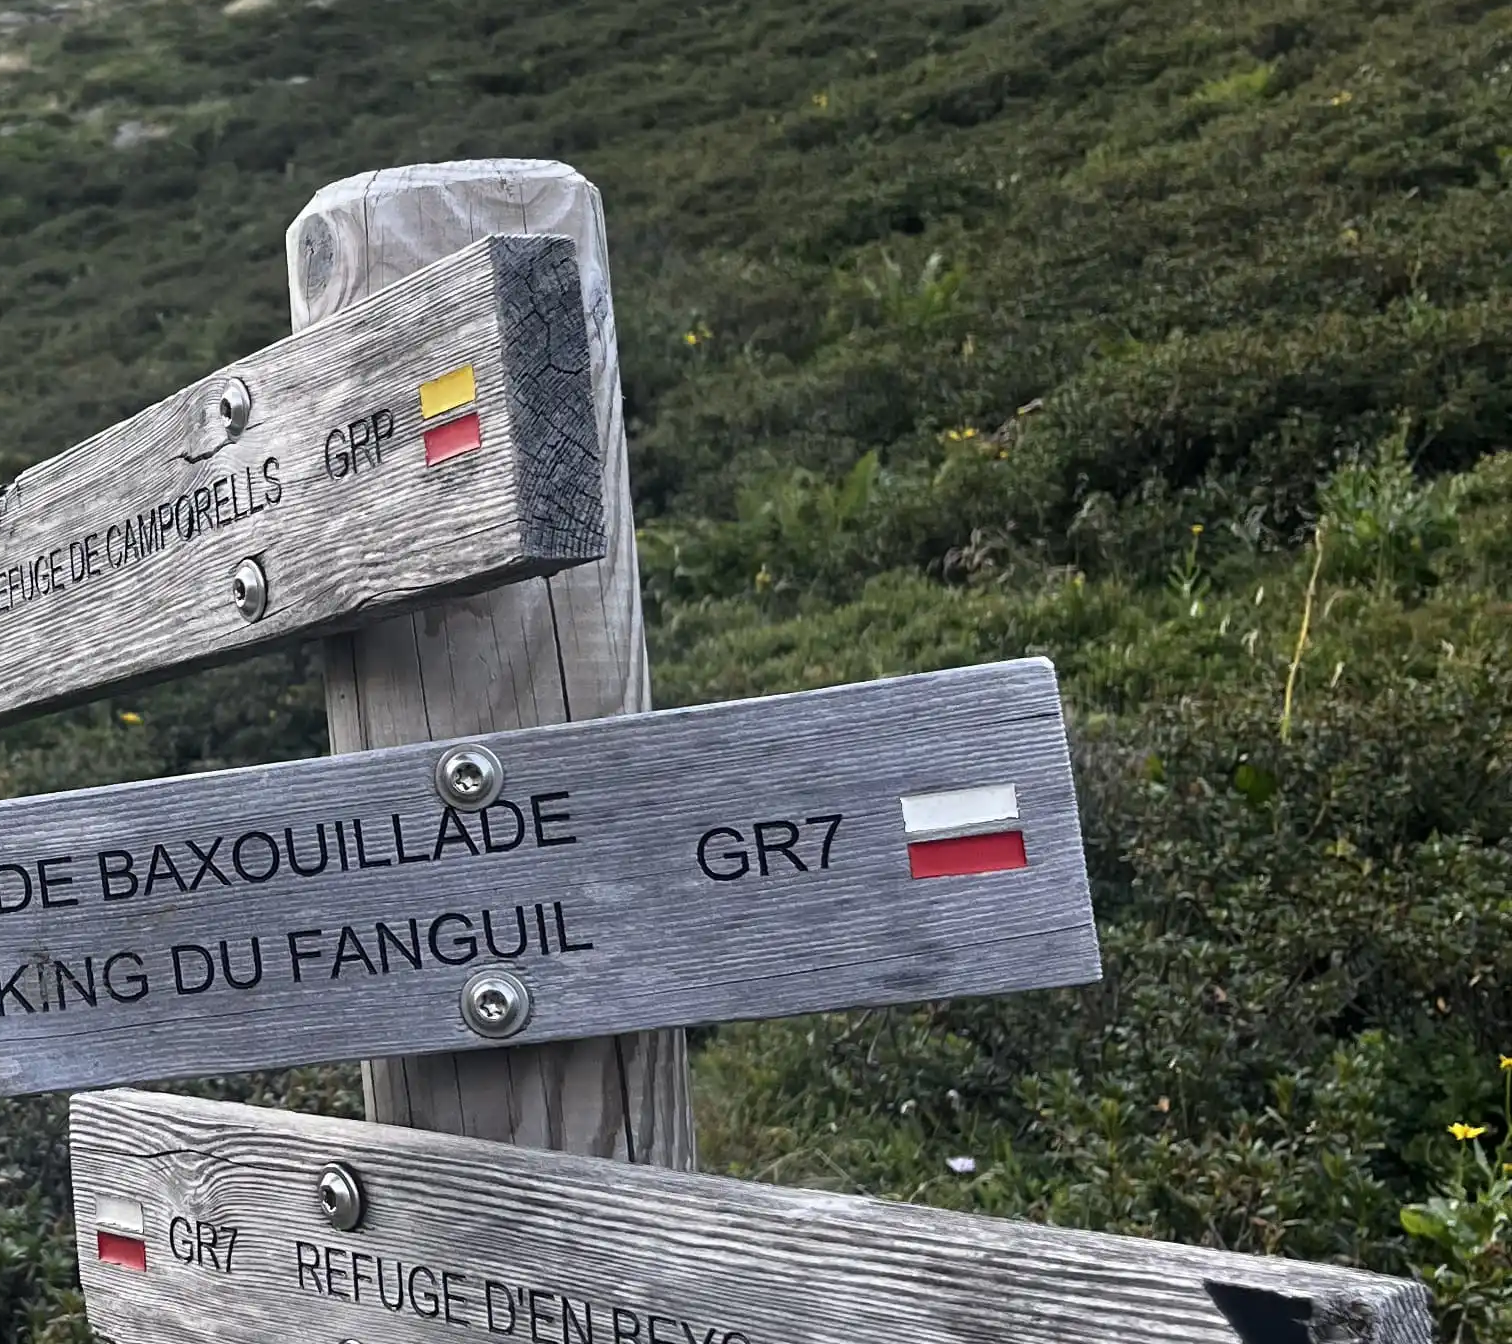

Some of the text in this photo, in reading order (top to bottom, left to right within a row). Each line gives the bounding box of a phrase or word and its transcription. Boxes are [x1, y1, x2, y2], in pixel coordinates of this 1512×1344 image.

[69, 535, 101, 583] DE
[106, 456, 284, 570] CAMPORELLS
[324, 409, 396, 481] GRP
[100, 791, 577, 900] BAXOUILLADE
[696, 814, 843, 882] GR7
[173, 937, 263, 996] DU
[288, 901, 593, 983] FANGUIL
[169, 1216, 238, 1273] GR7
[295, 1240, 469, 1326] REFUGE
